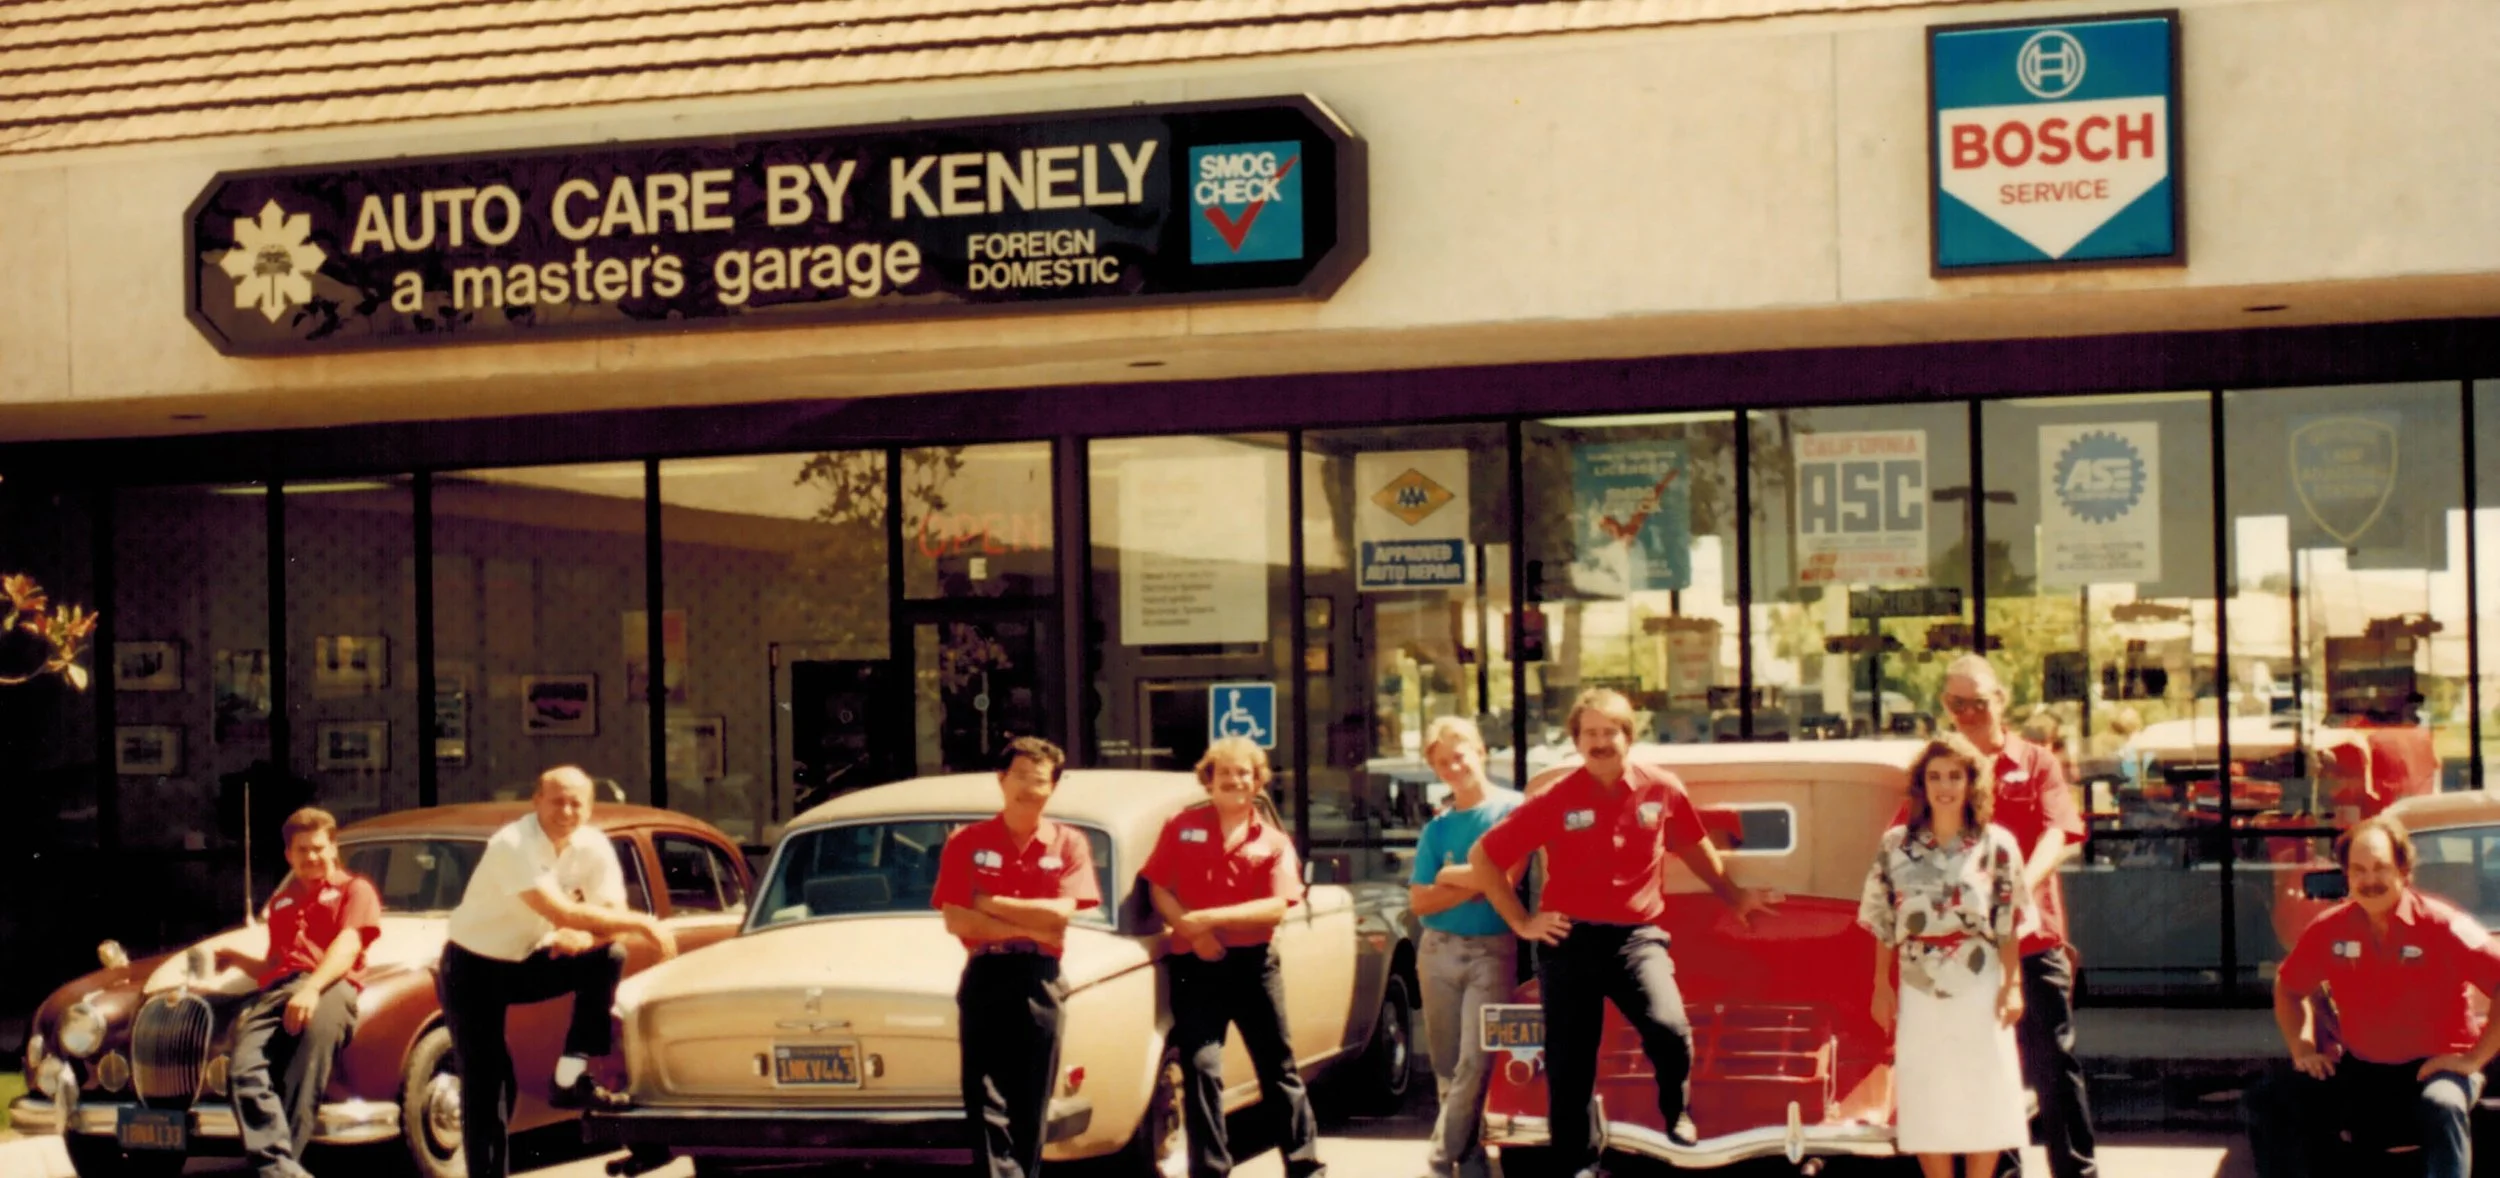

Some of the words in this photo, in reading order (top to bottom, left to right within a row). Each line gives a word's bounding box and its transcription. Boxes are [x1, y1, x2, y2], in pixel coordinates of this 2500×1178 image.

[1950, 111, 2155, 170] BOSCH
[1200, 151, 1277, 179] SMOG
[350, 186, 522, 254] AUTO
[551, 169, 734, 241] CARE
[766, 160, 857, 226] BY
[890, 140, 1158, 219] KENELY
[1194, 178, 1282, 205] CHECK
[1999, 178, 2110, 205] SERVICE
[967, 228, 1096, 260] FOREIGN
[391, 271, 423, 312] a
[453, 243, 685, 309] master's
[713, 240, 921, 305] garage
[968, 255, 1120, 290] DOMESTIC
[1803, 435, 1916, 456] CALIFORNIA
[2064, 458, 2132, 491] ASE
[1396, 485, 1428, 508] AAA
[1801, 460, 1923, 534] ASC
[918, 510, 1042, 558] OPEN
[1374, 544, 1453, 562] APPROVED
[1365, 564, 1408, 582] AUTO
[1408, 562, 1461, 581] REPAIR
[1485, 1022, 1546, 1045] PHEAT
